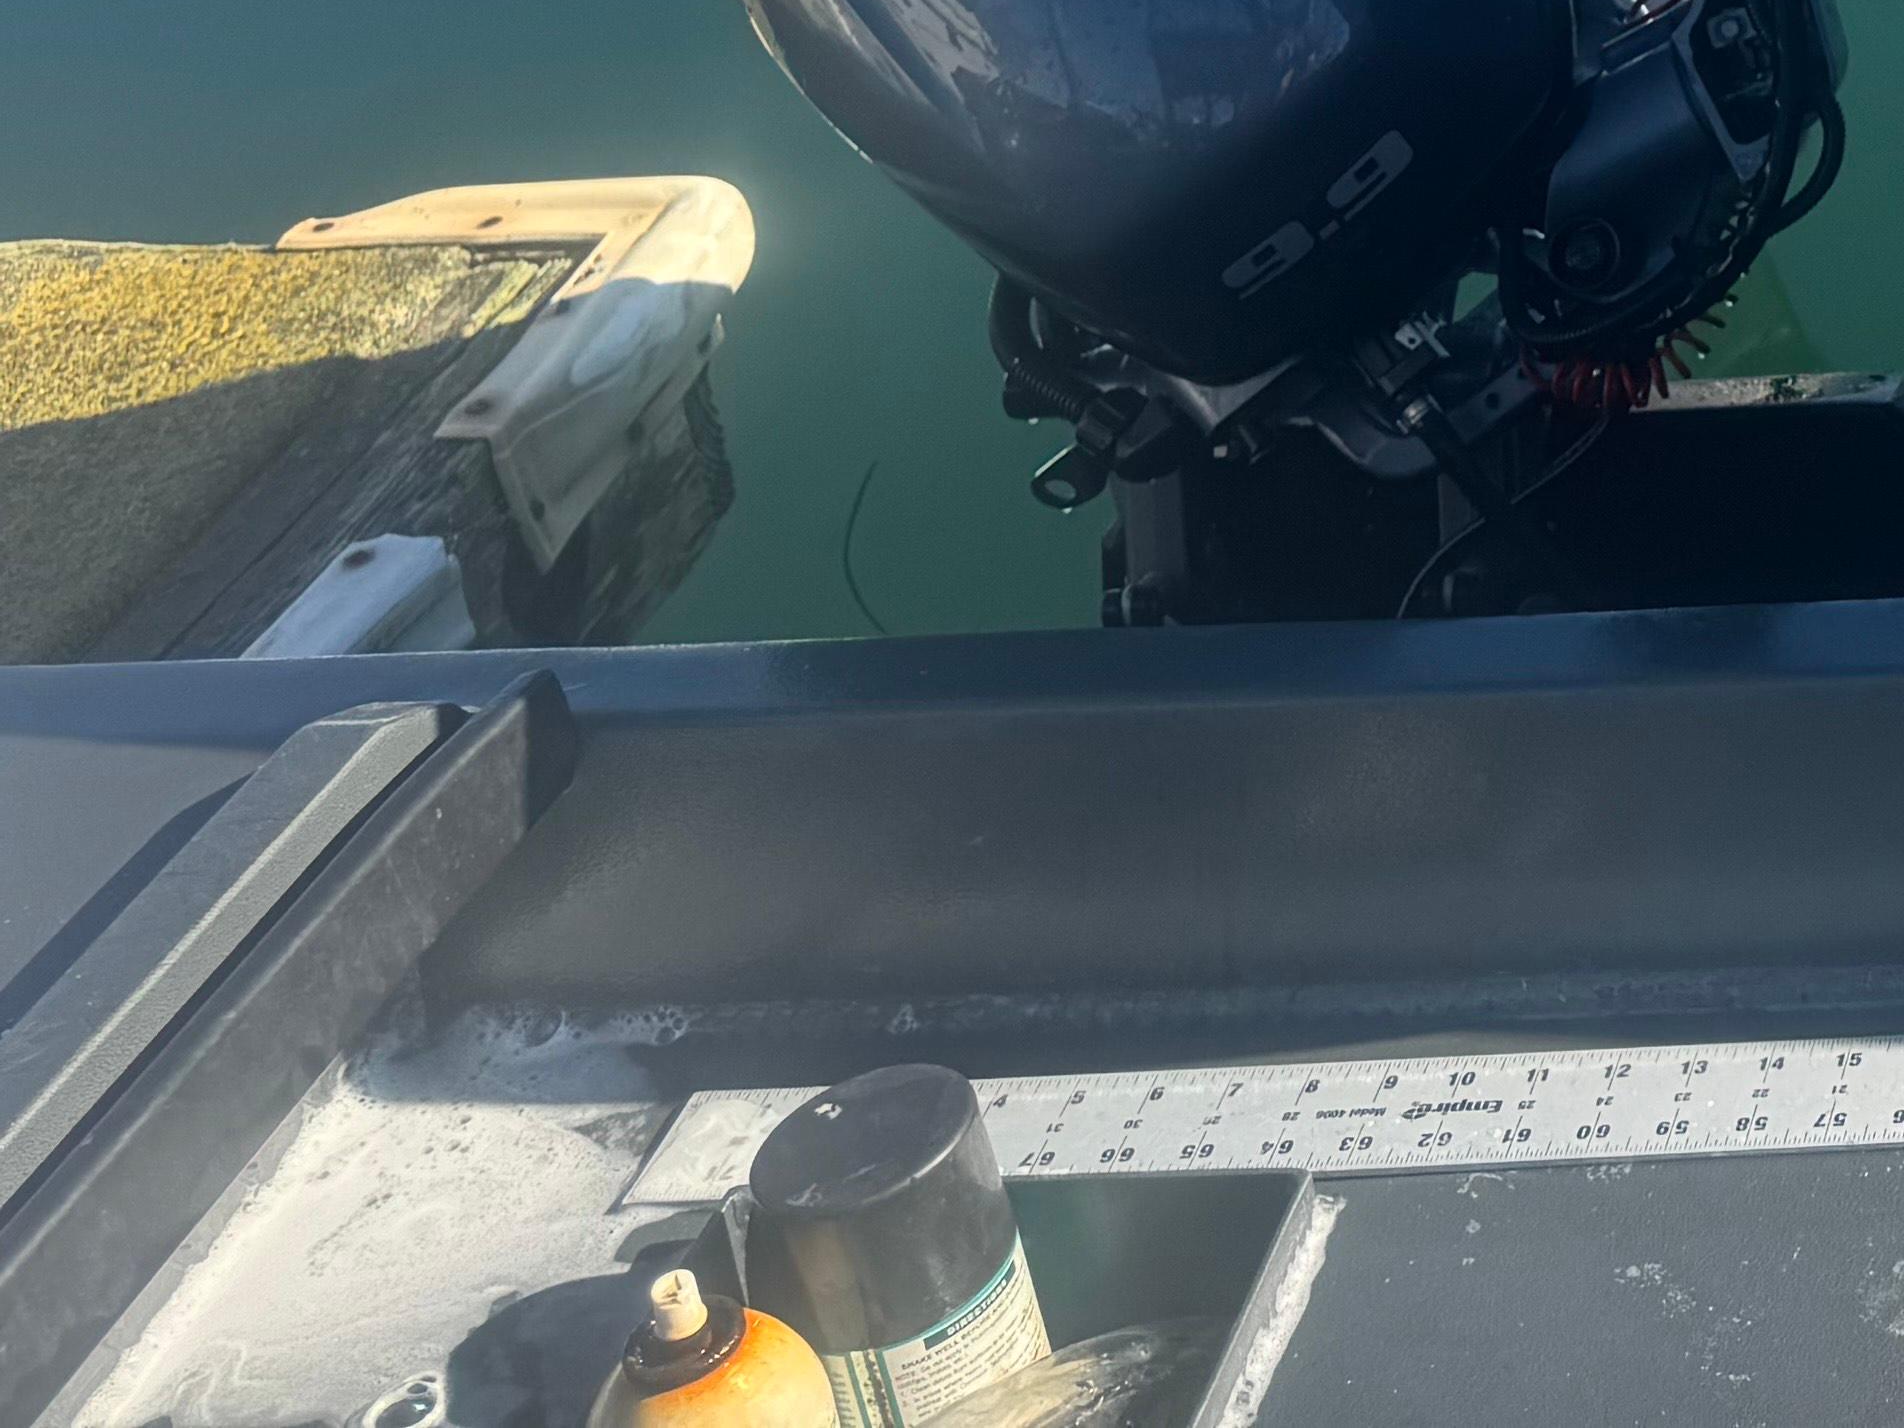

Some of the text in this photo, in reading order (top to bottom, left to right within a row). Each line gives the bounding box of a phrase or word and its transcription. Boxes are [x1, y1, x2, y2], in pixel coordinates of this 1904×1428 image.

[1221, 129, 1414, 300] 9.9
[1070, 1091, 1085, 1105] 5
[1150, 1087, 1165, 1101] 6
[1228, 1084, 1243, 1098] 7
[1305, 1080, 1320, 1094] 8
[1382, 1076, 1398, 1090] 9
[1449, 1072, 1476, 1086] 10
[1527, 1069, 1549, 1083] 11
[1604, 1066, 1631, 1080] 12
[1681, 1062, 1708, 1076] 13
[1760, 1059, 1785, 1073] 14
[1837, 1052, 1862, 1066] 15
[1417, 1097, 1503, 1116] Empire
[1813, 1111, 1847, 1127] 57
[1576, 1125, 1610, 1140] 60
[1656, 1121, 1689, 1136] 59
[1337, 1135, 1373, 1150] 63
[1418, 1132, 1452, 1147] 62
[1101, 1147, 1135, 1162] 66
[1180, 1143, 1214, 1158] 65
[1261, 1140, 1295, 1155] 64
[1019, 1150, 1055, 1165] 67
[946, 1279, 1008, 1336] DIRECTIONS
